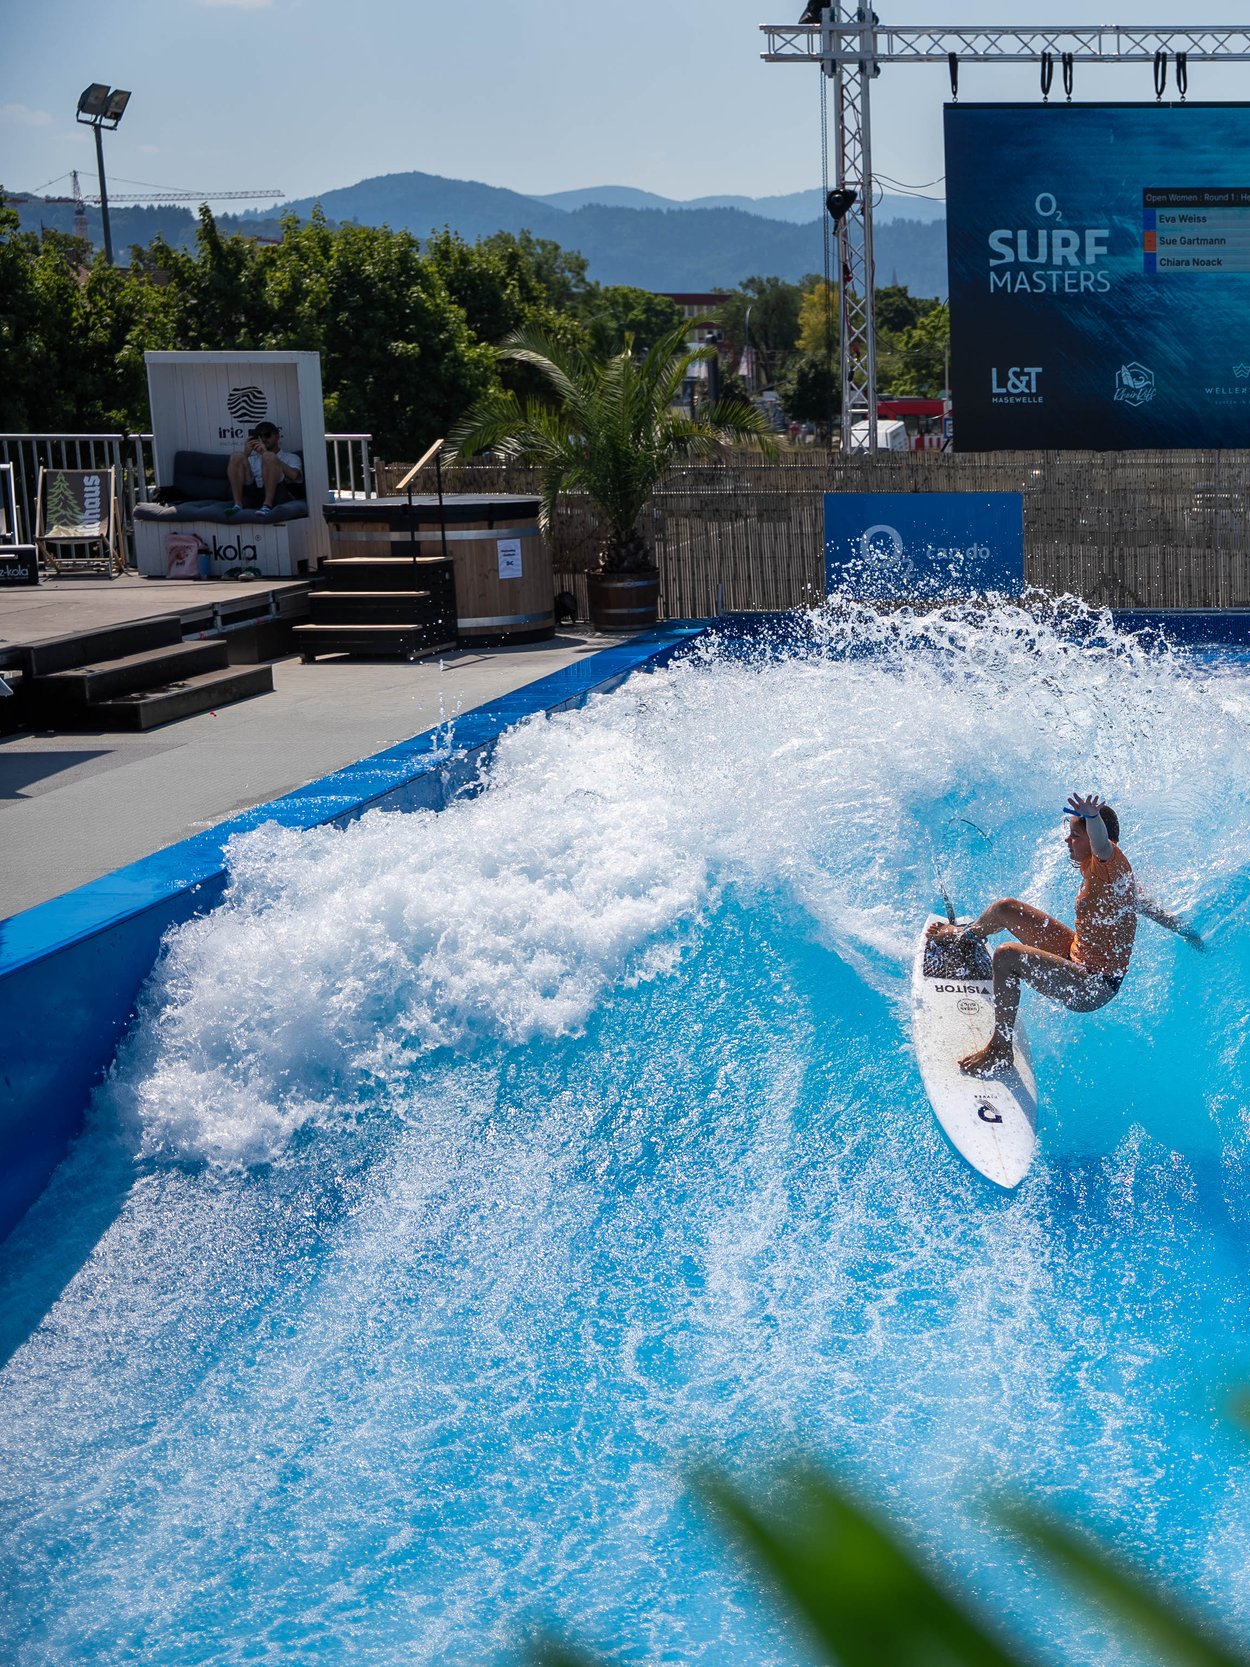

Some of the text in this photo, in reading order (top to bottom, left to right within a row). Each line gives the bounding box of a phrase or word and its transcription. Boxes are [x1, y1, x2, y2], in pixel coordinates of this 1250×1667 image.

[1145, 193, 1167, 202] Open
[1170, 193, 1198, 201] Women
[1204, 193, 1229, 201] Round
[1159, 214, 1207, 224] Eva Weiss
[1159, 236, 1226, 246] Sue Gartmann
[988, 229, 1110, 267] SURF
[1159, 258, 1222, 267] Chiara Noack
[990, 270, 1111, 293] MASTERS
[991, 367, 1043, 394] L&T
[992, 396, 1044, 404] HASEWELLE
[218, 426, 244, 439] irie
[966, 542, 990, 560] do
